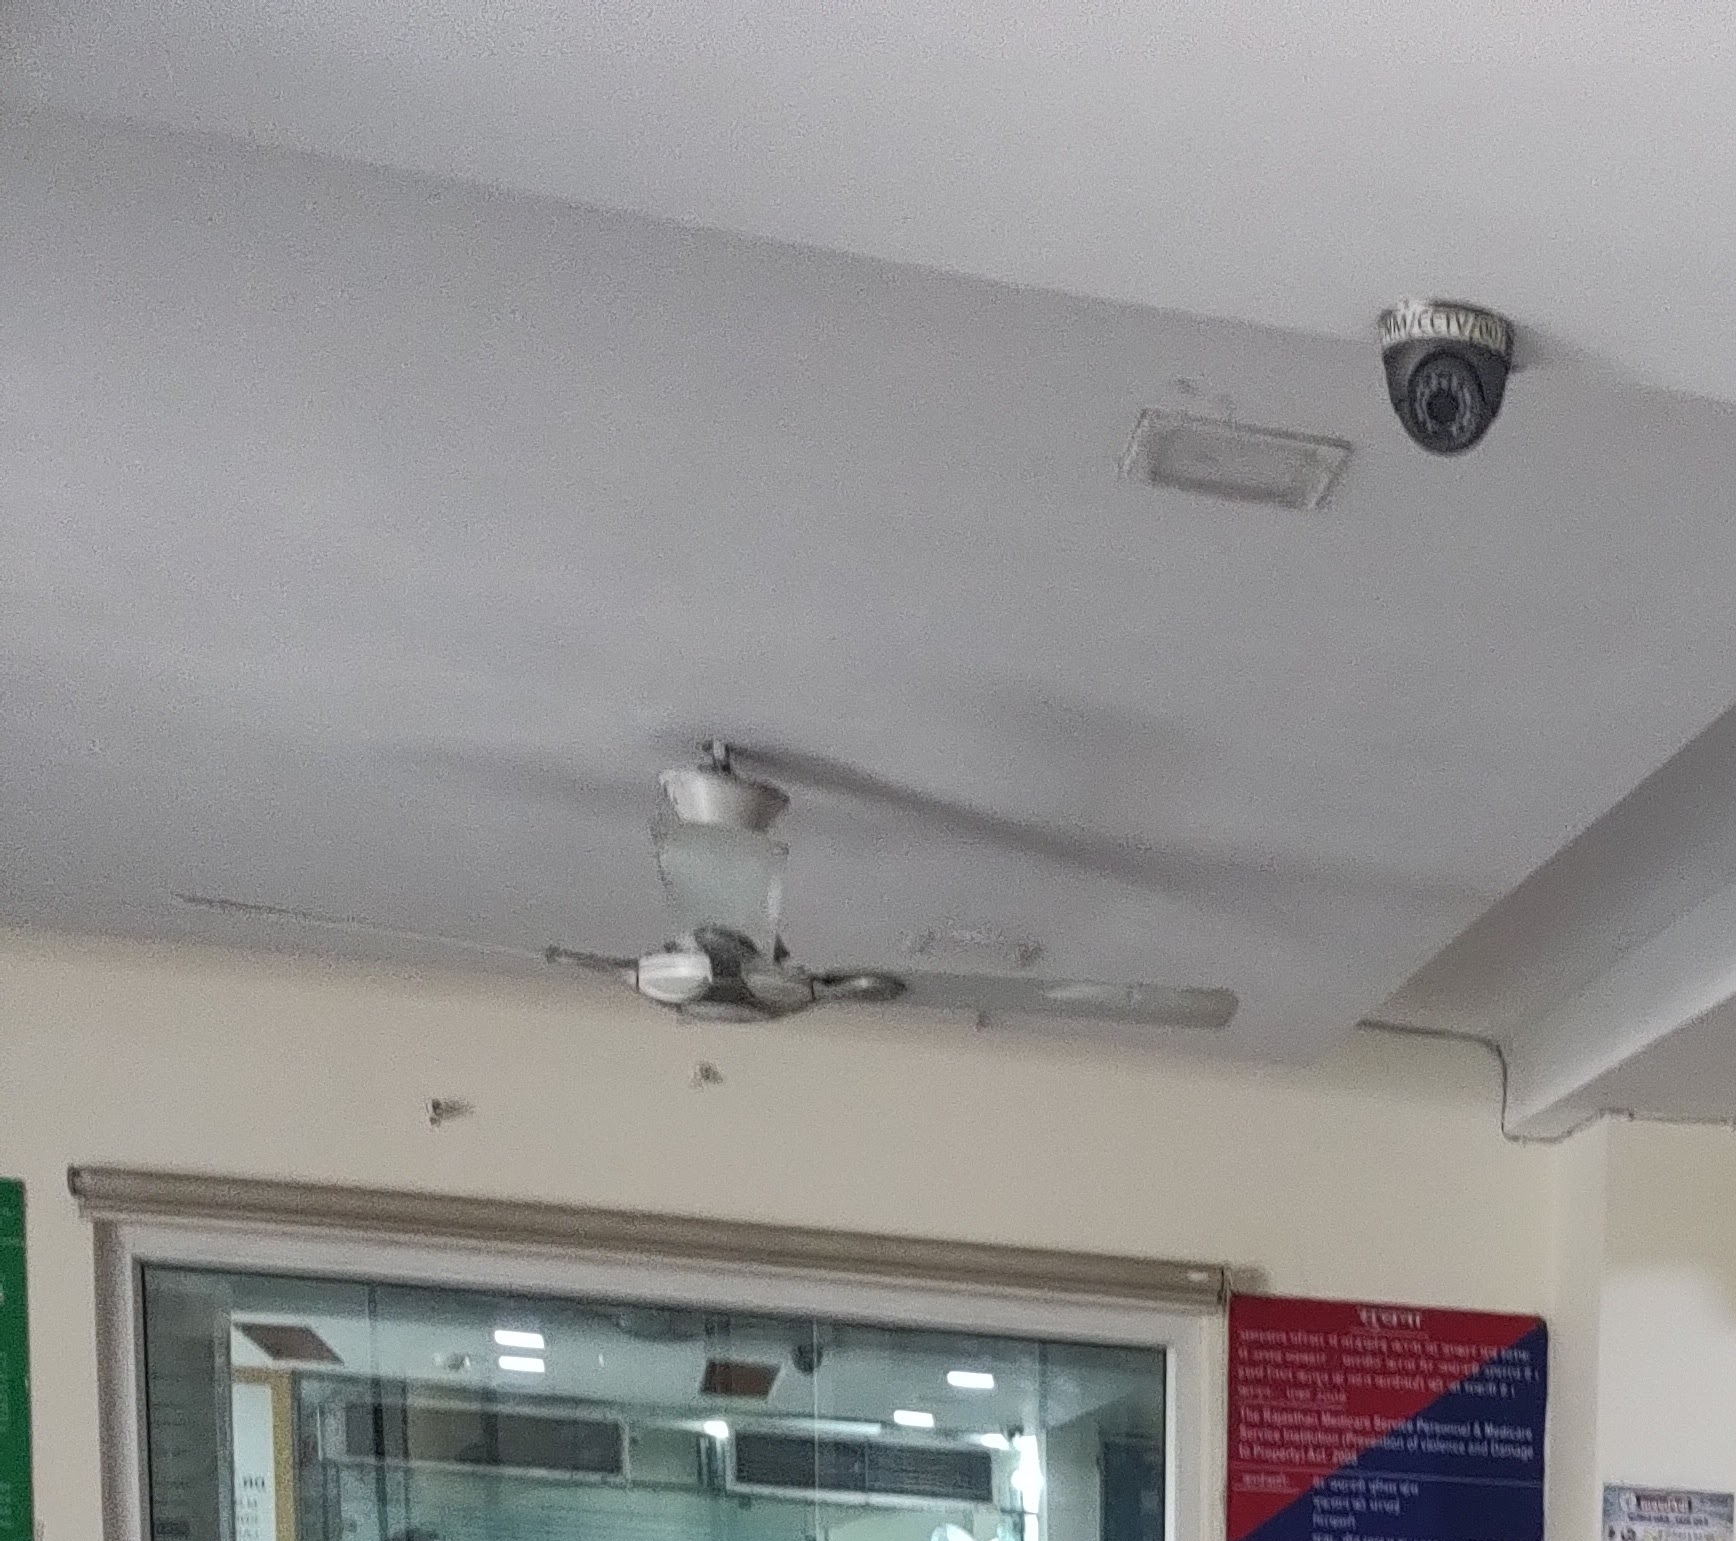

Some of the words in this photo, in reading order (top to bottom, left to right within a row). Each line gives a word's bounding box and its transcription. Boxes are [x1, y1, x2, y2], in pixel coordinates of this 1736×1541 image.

[1240, 1406, 1260, 1421] The
[1321, 1411, 1370, 1429] Medicare
[1373, 1414, 1413, 1432] Service
[1416, 1417, 1470, 1435] Personnel
[1484, 1422, 1532, 1440] Medicare
[1406, 1435, 1417, 1450] of
[1467, 1440, 1488, 1455] and
[1490, 1441, 1534, 1459] Damage
